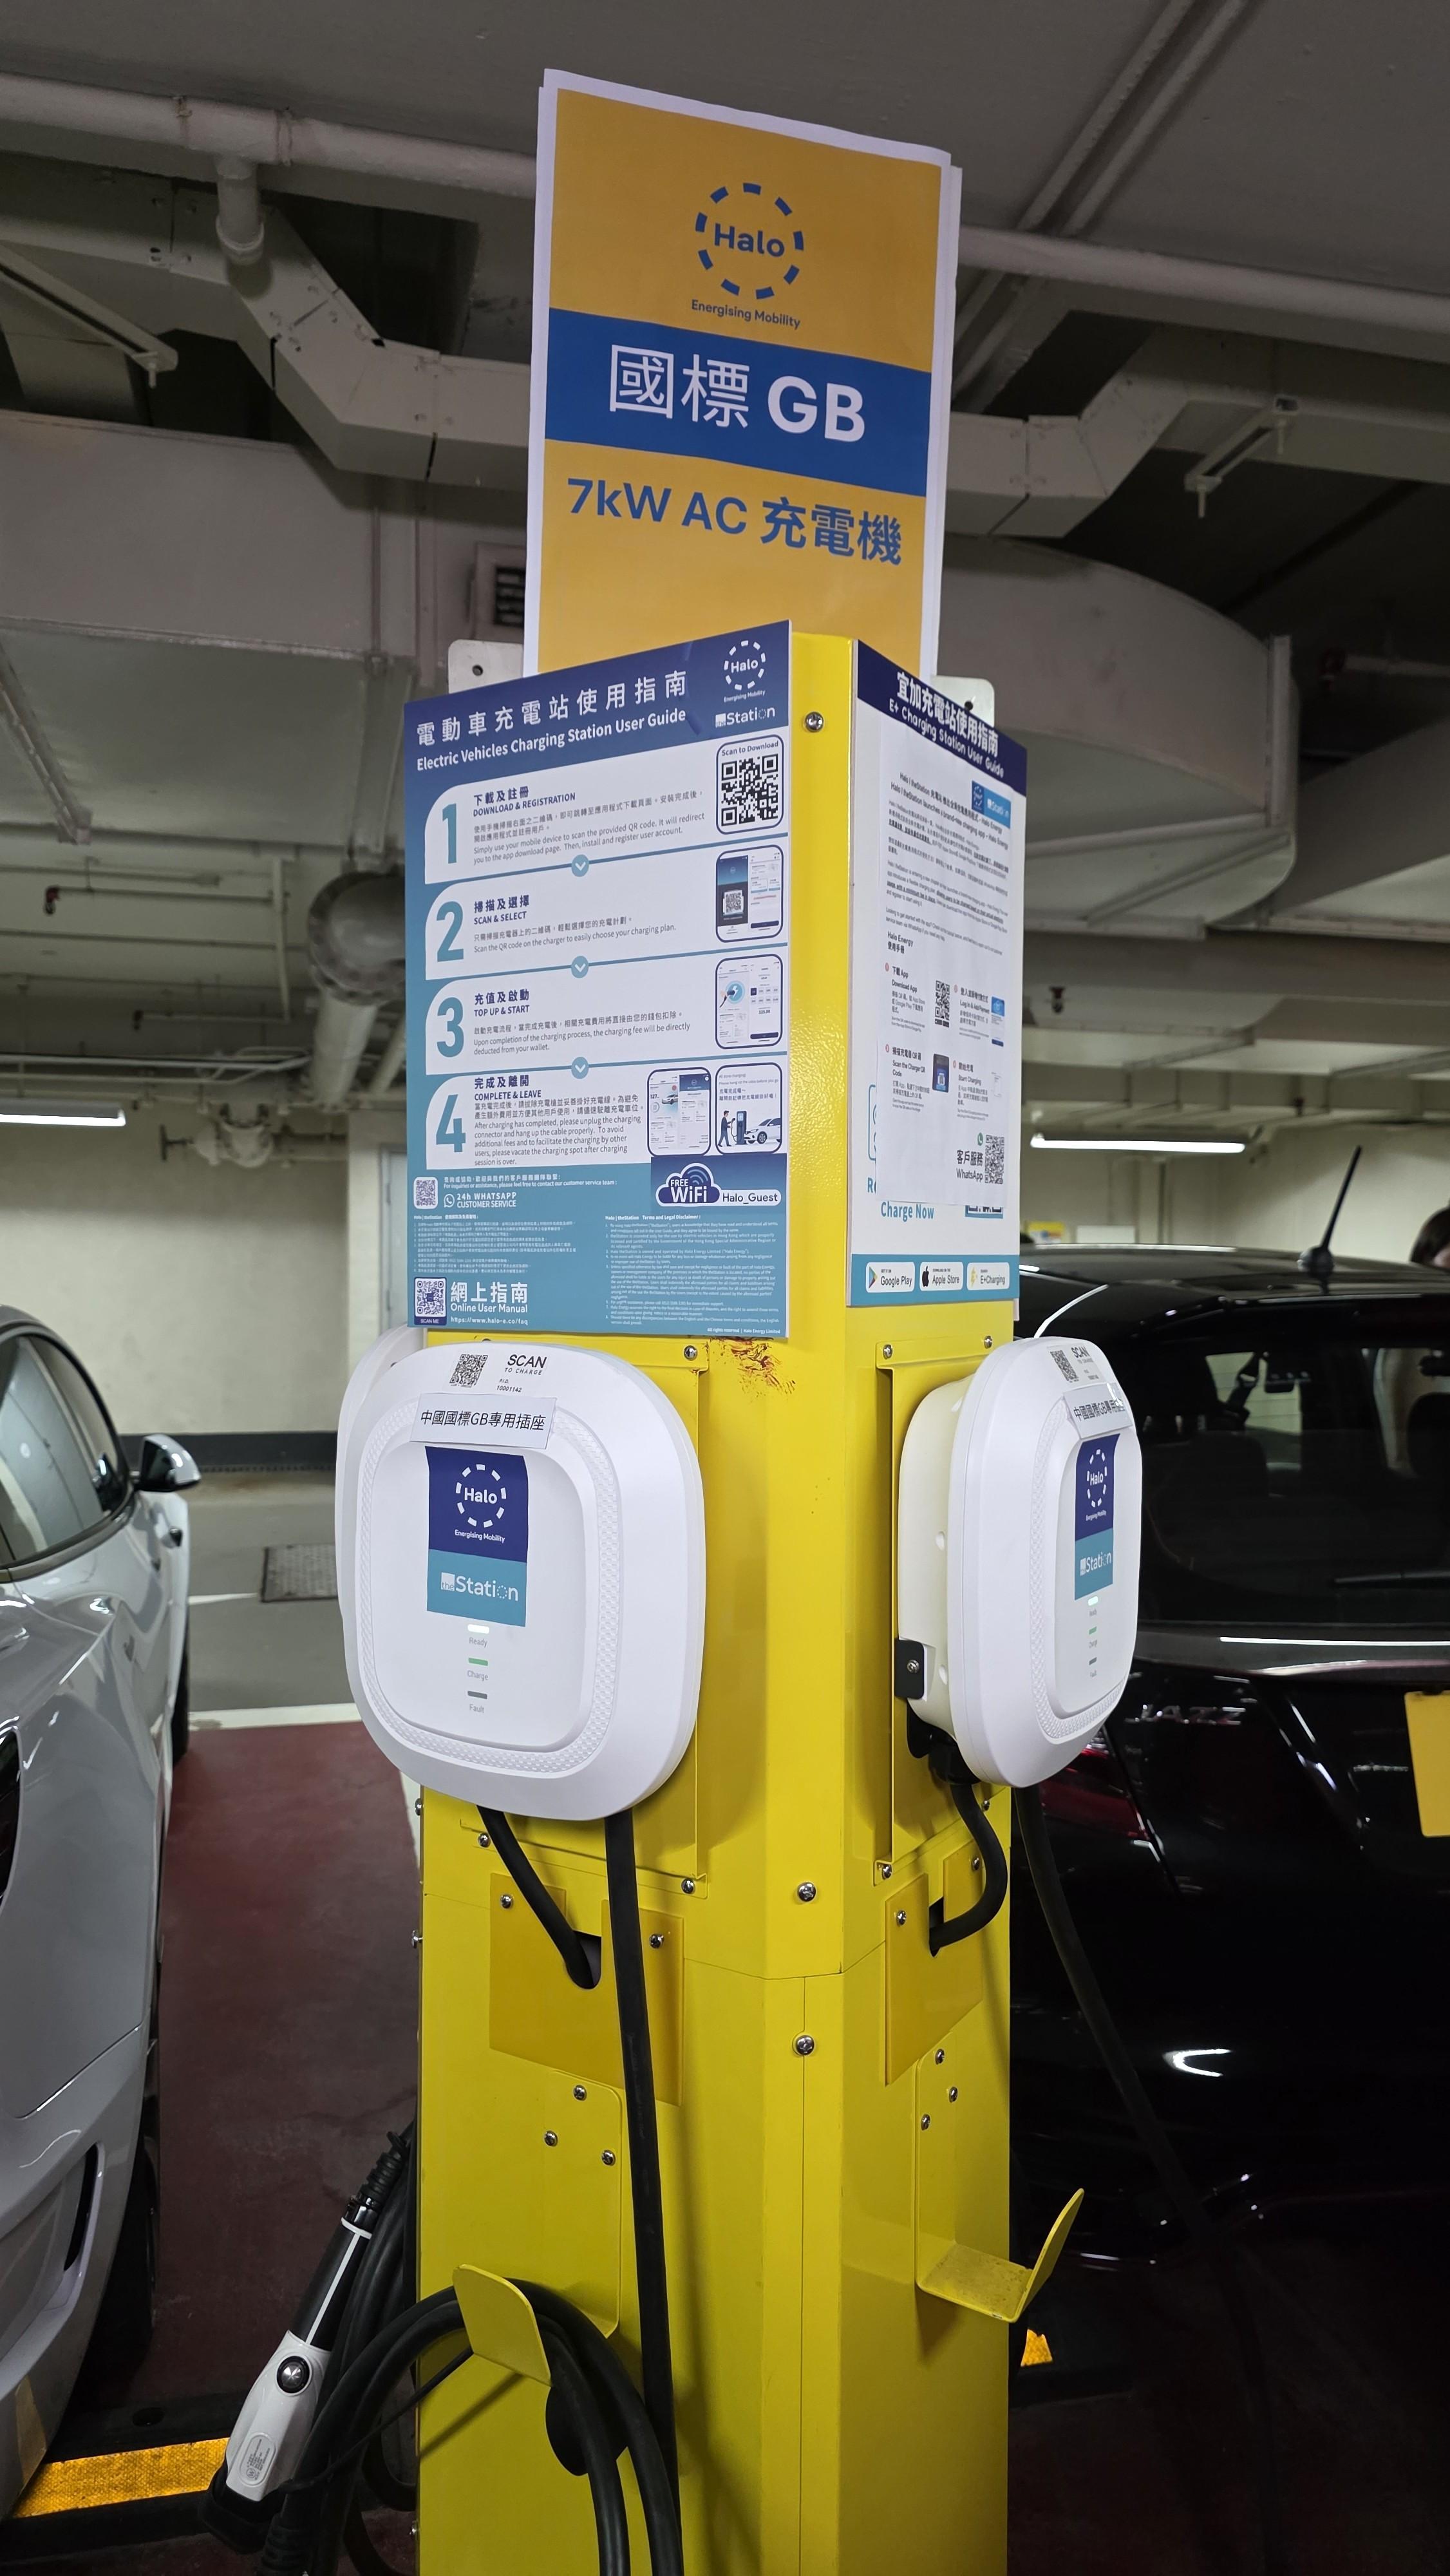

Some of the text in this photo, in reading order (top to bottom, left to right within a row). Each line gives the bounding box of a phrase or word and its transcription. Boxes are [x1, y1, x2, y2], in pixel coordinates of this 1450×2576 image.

[714, 223, 785, 257] Halo
[692, 299, 800, 330] Energising Mobility
[609, 344, 865, 442] 國標 GB
[567, 478, 901, 565] 7kW AC 充電機
[731, 659, 758, 673] Halo
[724, 692, 746, 703] Energising
[417, 670, 686, 746] 電動車充電站使用指南
[897, 671, 998, 757] 宜加充電站使用指南
[417, 708, 686, 771] Electric Vehicles Charging Station User Guide
[889, 698, 1004, 778] E+ Charging Station User Guide
[748, 741, 778, 752] Download
[474, 786, 529, 806] 下載及註冊
[473, 802, 514, 817] DOWNLOAD
[523, 792, 576, 809] REGISTRATION
[442, 803, 457, 864] 1
[474, 844, 492, 855] Simply
[506, 840, 518, 851] your
[520, 836, 541, 847] mobile
[543, 834, 561, 844] device
[599, 824, 626, 837] provided
[628, 822, 637, 832] QR
[640, 820, 657, 829] code.
[659, 817, 664, 826] It
[666, 816, 677, 825] will
[679, 813, 704, 823] redirect
[475, 895, 529, 913] 掃描及選擇
[474, 916, 492, 924] SCAN
[500, 911, 527, 922] SELECT
[437, 901, 464, 962] 2
[888, 931, 913, 947] Halo Energy
[475, 989, 529, 1005] 充值及啟動
[474, 1009, 488, 1017] TOP
[507, 1005, 530, 1014] START
[437, 997, 464, 1057] 3
[490, 1036, 522, 1046] completion
[540, 1032, 566, 1042] charging
[605, 1027, 632, 1037] charging
[666, 1022, 690, 1031] directly
[474, 1046, 500, 1055] deducted
[475, 1075, 529, 1090] 完成及離開
[475, 1092, 511, 1101] COMPLETE
[520, 1090, 541, 1098] LEAVE
[436, 1094, 466, 1153] 4
[489, 1120, 513, 1130] charging
[525, 1119, 559, 1129] completed,
[560, 1117, 579, 1126] please
[614, 1115, 641, 1124] charging
[957, 1150, 983, 1166] 客戶服務
[956, 1168, 983, 1183] WhatsApp
[670, 1186, 707, 1202] WiFi
[722, 1193, 778, 1204] Halo_Guest
[881, 1201, 934, 1222] Charge Now
[880, 1275, 912, 1288] Google Play
[932, 1274, 959, 1284] Apple Store
[980, 1275, 1005, 1285] E+Charging
[451, 1282, 528, 1303] 網上指南
[451, 1303, 527, 1312] Online User Manual
[451, 1316, 528, 1325] https://www.halo-e.co/faq
[507, 1354, 547, 1368] SCAN
[1073, 1398, 1125, 1421] 中國國標GB專用
[420, 1409, 546, 1431] 中國國標GB專用插座
[1090, 1471, 1104, 1486] Halo
[464, 1487, 498, 1504] Halo
[455, 1529, 505, 1544] Energising Mobility
[469, 1637, 487, 1647] Ready
[467, 1670, 488, 1681] Charge
[469, 1703, 484, 1713] Fault
